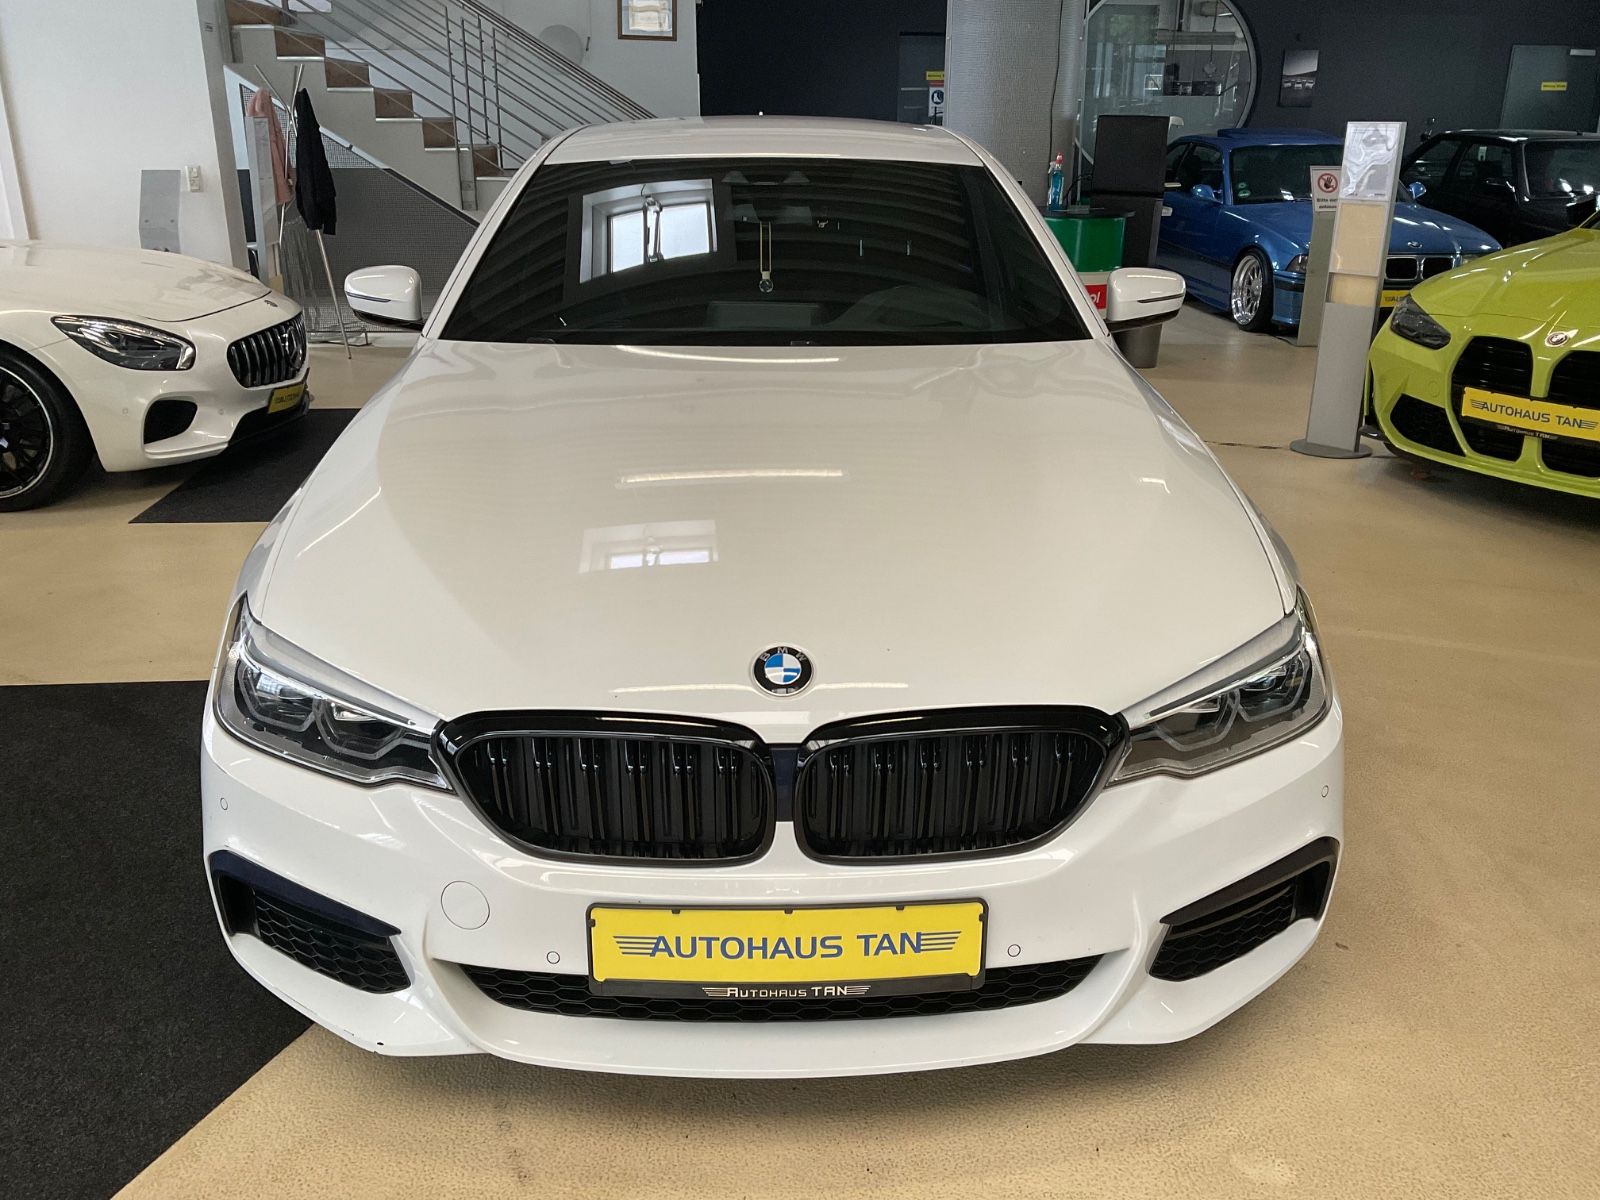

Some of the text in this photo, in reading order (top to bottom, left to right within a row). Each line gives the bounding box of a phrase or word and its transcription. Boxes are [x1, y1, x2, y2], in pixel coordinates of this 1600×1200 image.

[1480, 401, 1583, 429] AUTOHAUS TAN
[760, 646, 807, 662] BMW
[649, 931, 922, 960] AUTOHAUS TAN
[811, 985, 848, 997] TAN
